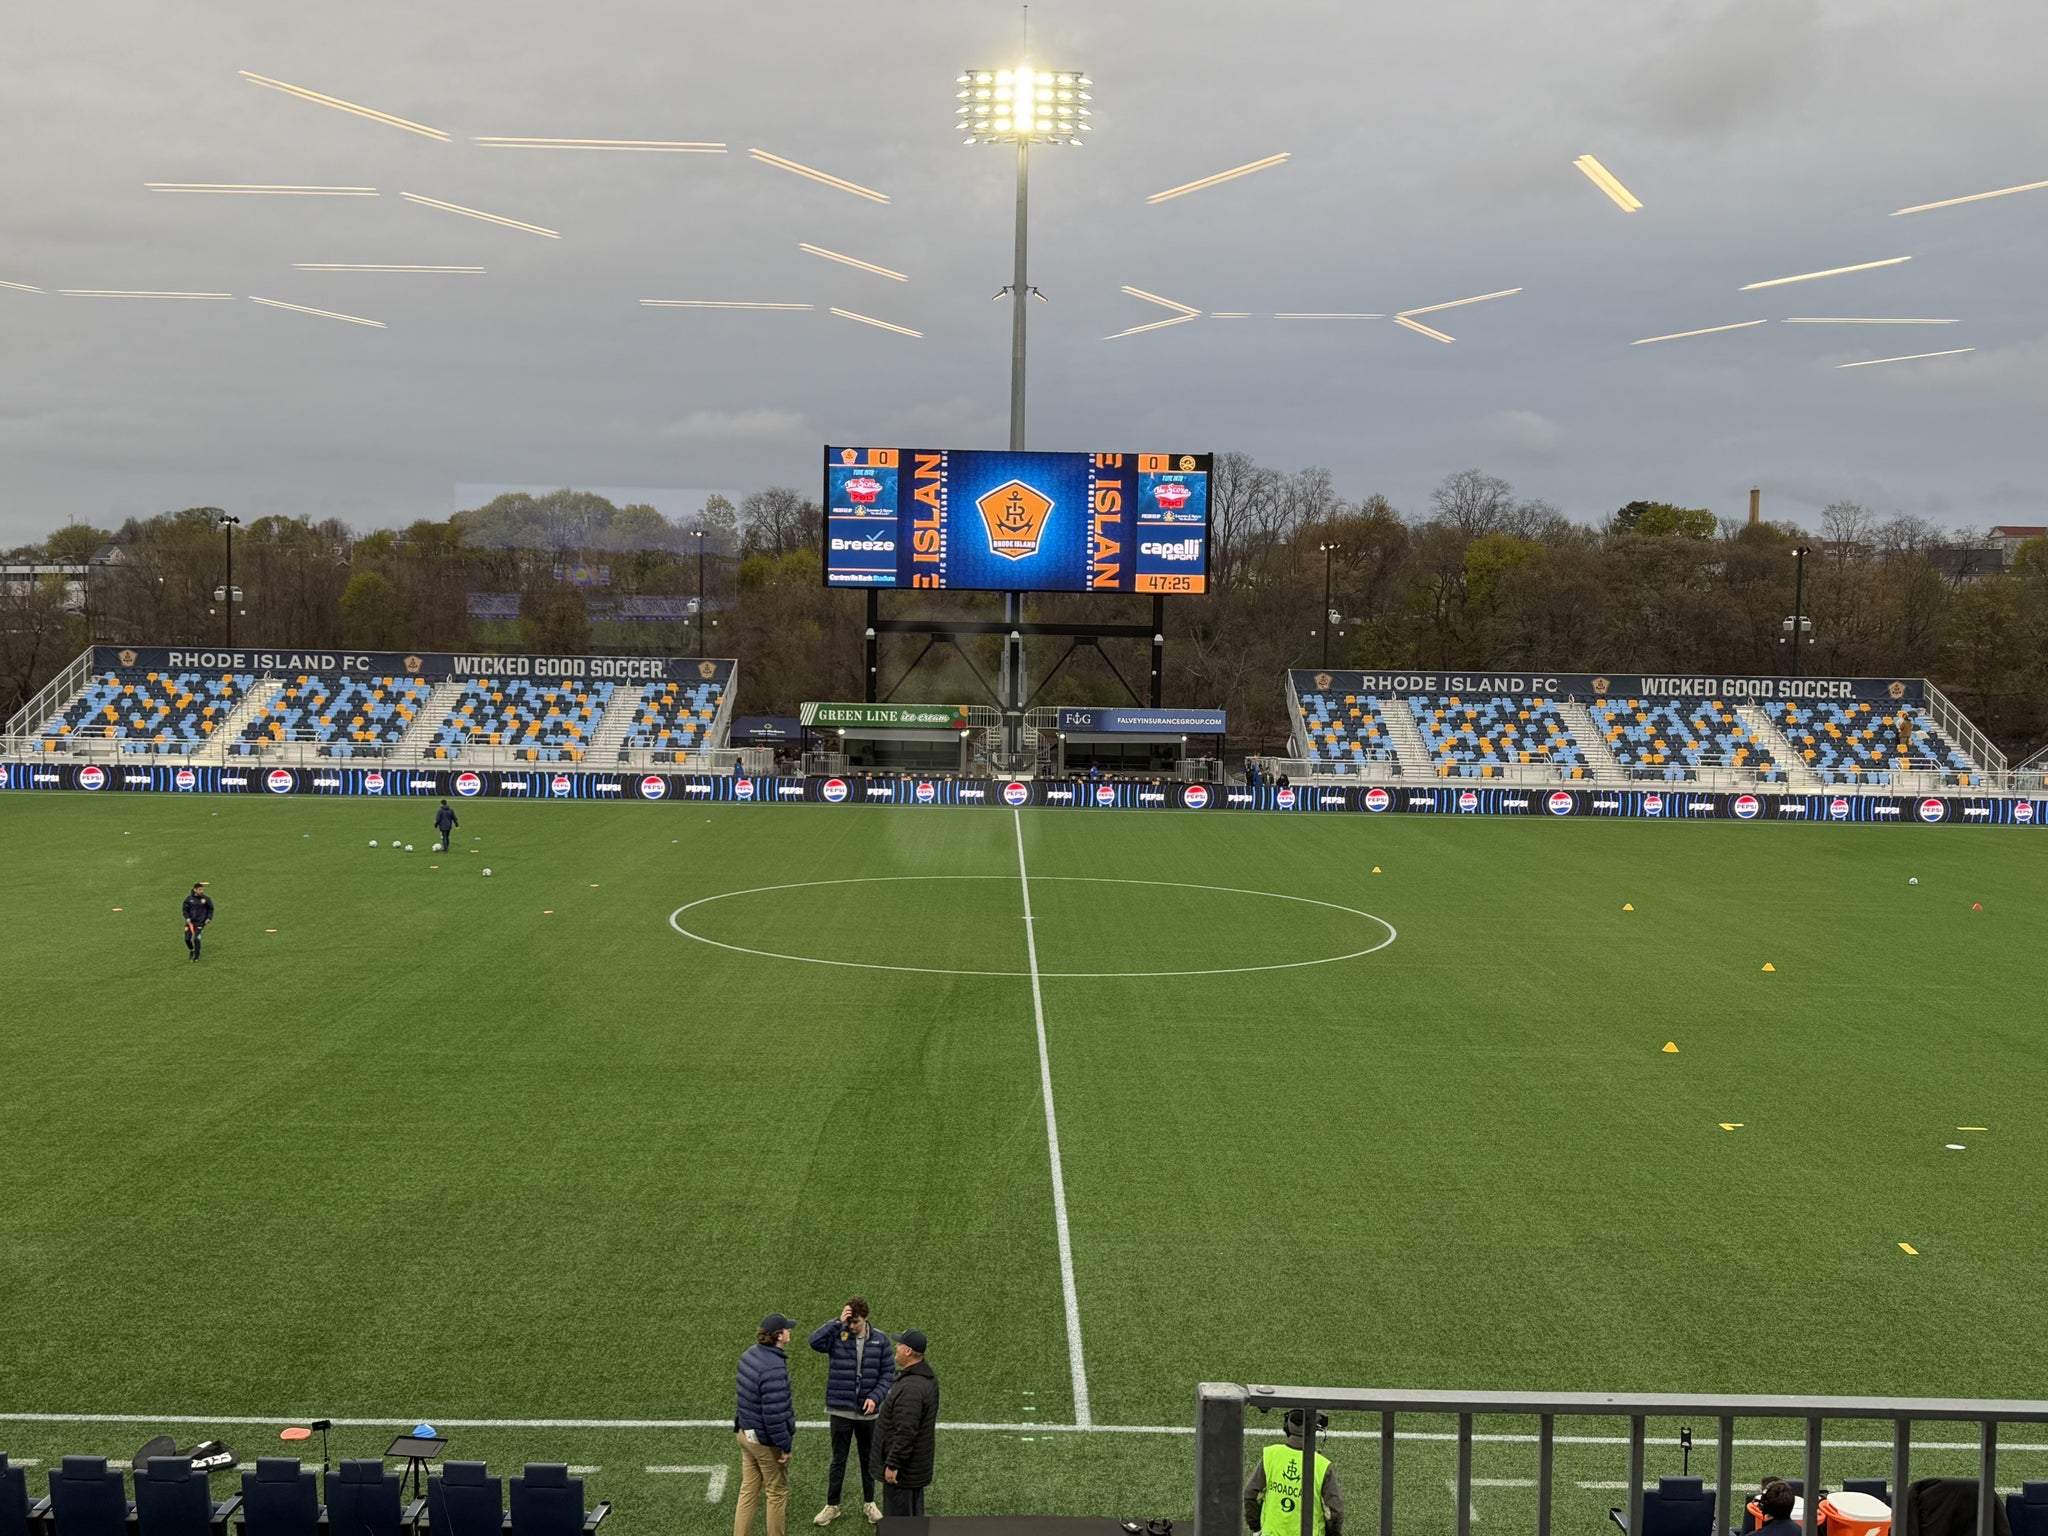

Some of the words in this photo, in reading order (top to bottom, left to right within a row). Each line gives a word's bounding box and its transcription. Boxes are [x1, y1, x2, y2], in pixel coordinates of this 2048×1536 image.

[880, 452, 888, 464] 0
[1150, 456, 1158, 470] 0
[831, 539, 894, 551] Breeze
[1141, 539, 1199, 559] capelli
[1149, 577, 1190, 590] 47:25
[169, 652, 246, 668] RHODE
[253, 654, 336, 670] ISLAND
[343, 656, 370, 671] FC
[454, 656, 530, 676] WICKED
[534, 658, 586, 678] GOOD
[590, 659, 668, 678] SOCCER.
[1362, 676, 1437, 691] RHODE
[1445, 677, 1525, 692] ISLAND
[1532, 678, 1558, 692] FC
[1641, 678, 1717, 696] WICKED
[1722, 679, 1774, 698] GOOD
[1778, 680, 1857, 699] SOCCER.
[819, 710, 862, 721] GREEN
[867, 710, 898, 722] LINE
[900, 710, 916, 722] ice
[917, 714, 950, 723] cream
[34, 774, 59, 782] PEPSI
[960, 790, 984, 798] PEPSI
[1048, 791, 1072, 799] PEPSI
[1228, 794, 1252, 802] PEPSI
[1321, 796, 1345, 804] PEPSI
[1281, 1497, 1295, 1512] 9
